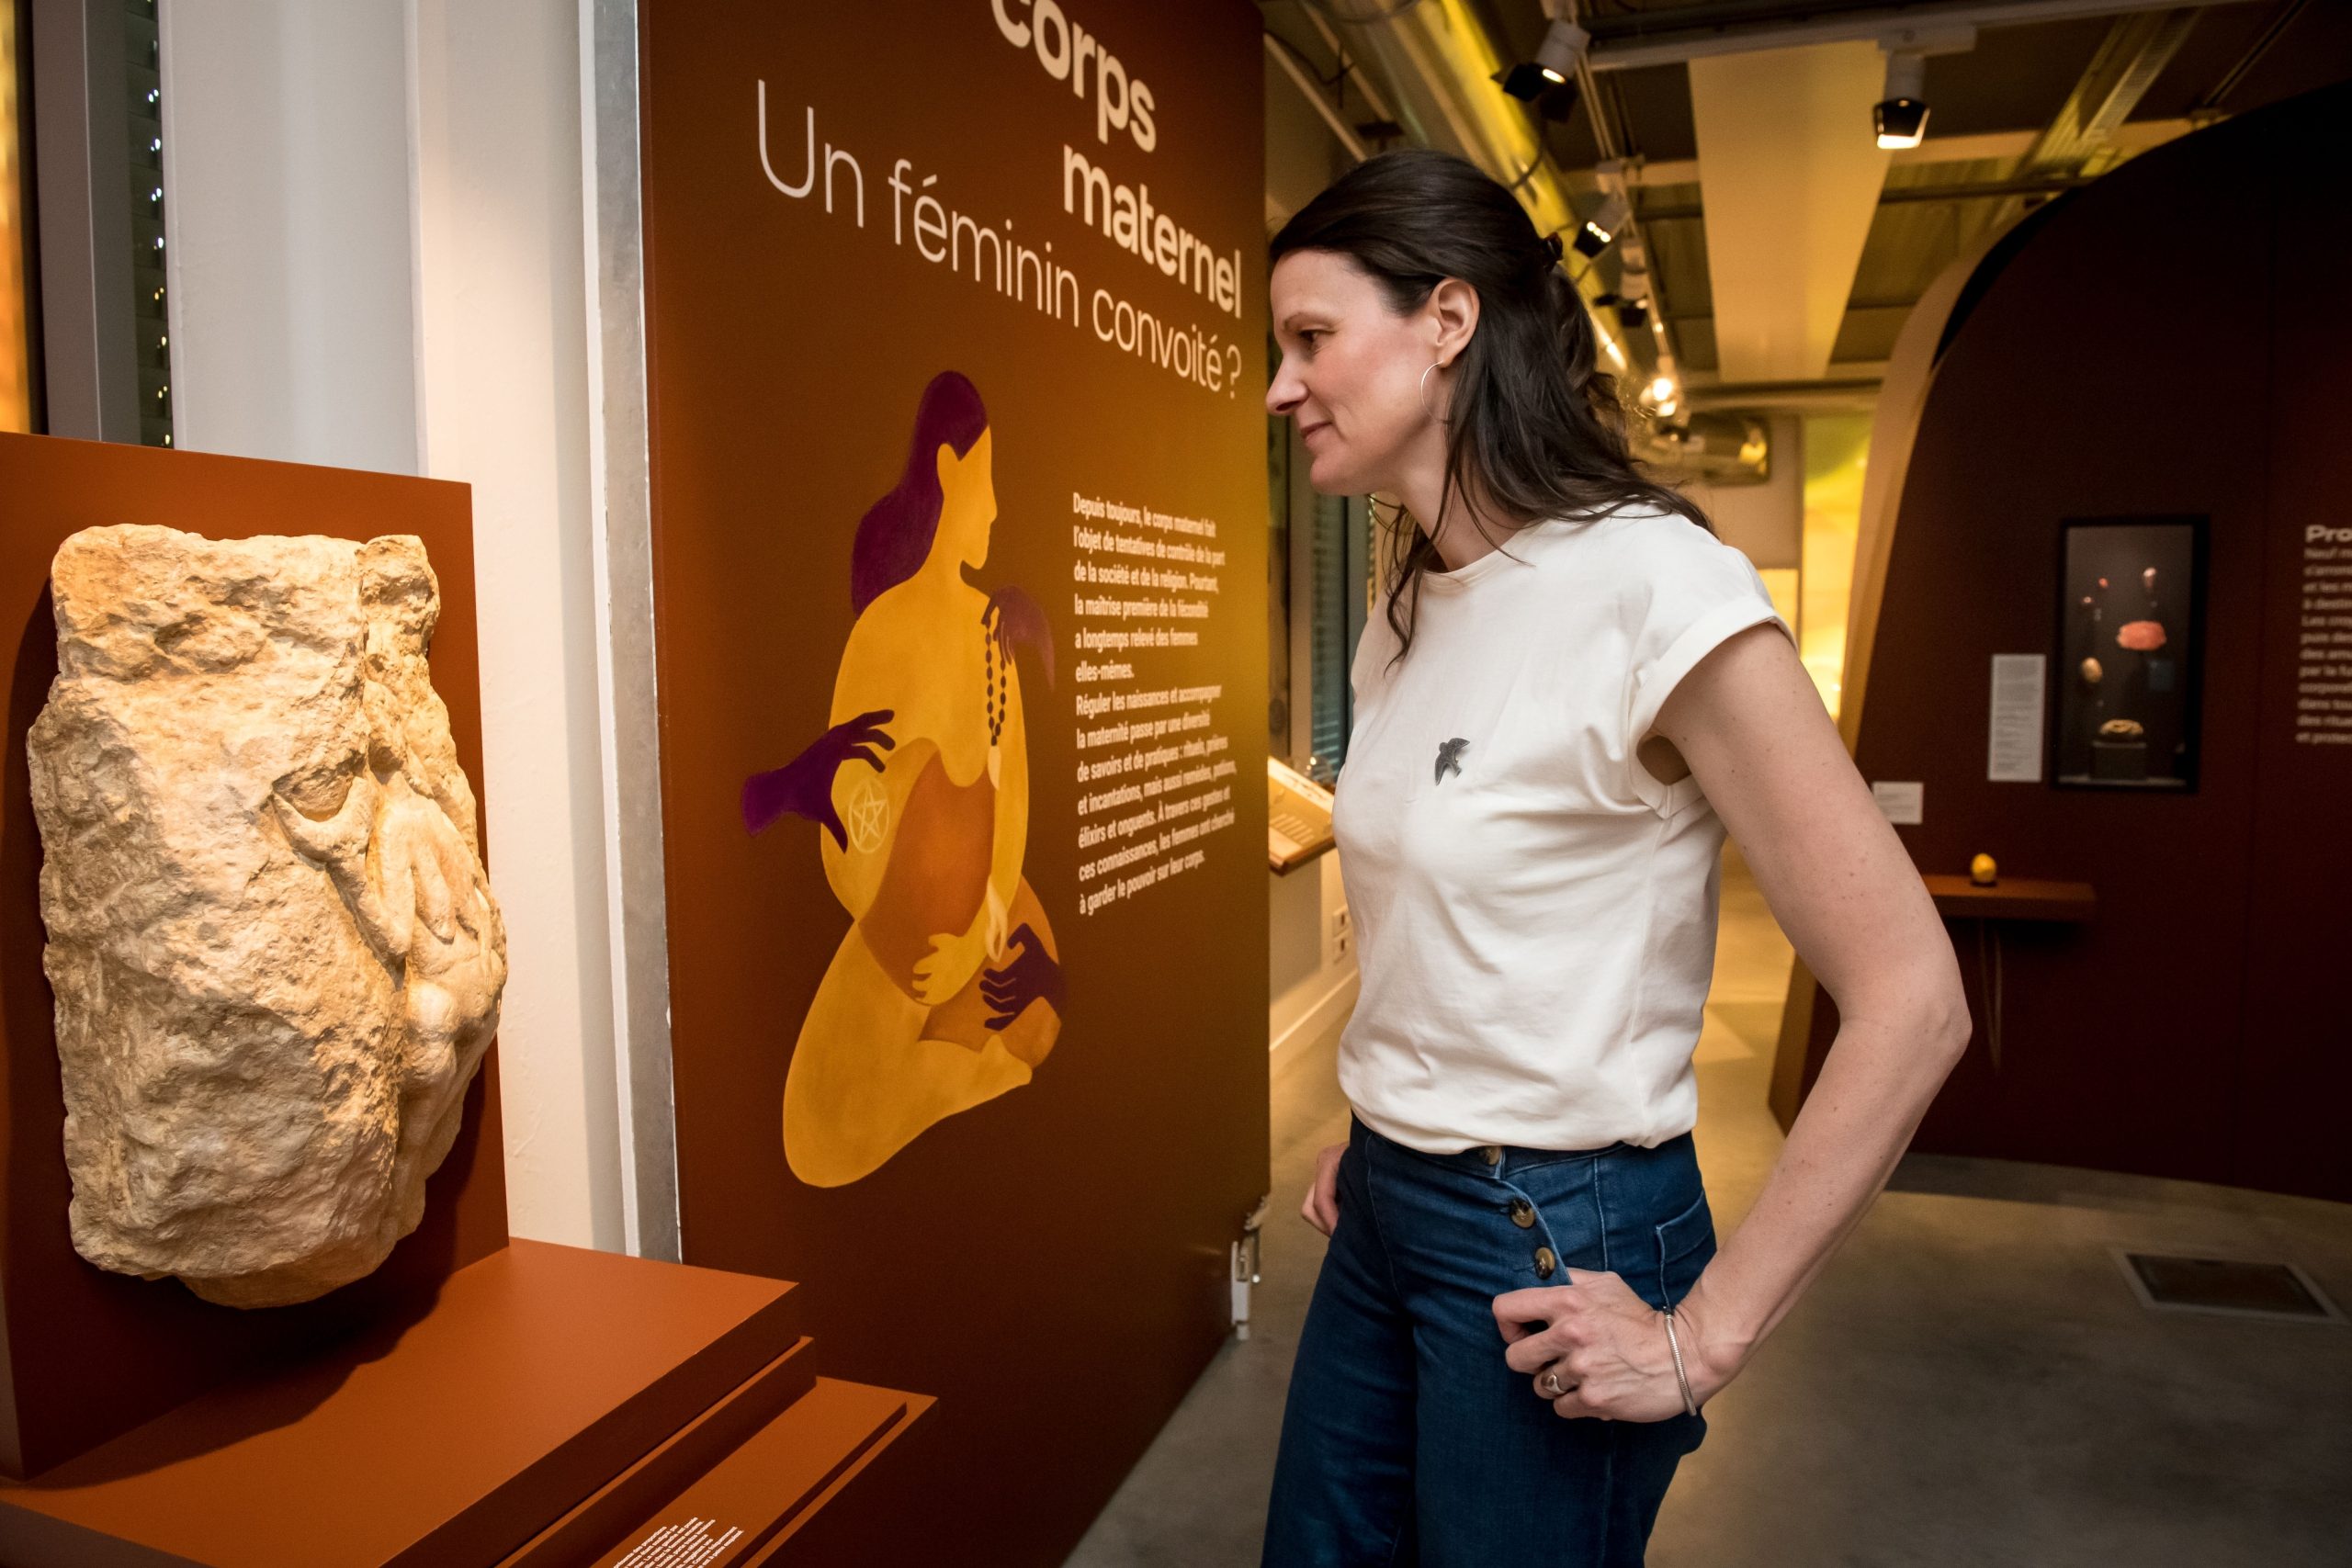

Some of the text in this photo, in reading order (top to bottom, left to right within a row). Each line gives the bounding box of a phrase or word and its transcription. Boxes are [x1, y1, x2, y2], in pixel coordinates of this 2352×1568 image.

[991, 0, 1158, 153] corps
[757, 79, 865, 228] Un
[888, 158, 1080, 328] féminin
[1063, 143, 1243, 319] maternel
[1073, 492, 1105, 520] Depuis
[1107, 501, 1143, 528] toujours,
[1144, 506, 1151, 526] le
[1153, 513, 1173, 533] corps
[1174, 516, 1204, 536] maternel
[1102, 530, 1114, 551] de
[1115, 535, 1155, 557] tentatives
[1156, 539, 1166, 558] de
[1167, 543, 1194, 561] contrôle
[1196, 546, 1204, 563] de
[1204, 547, 1211, 564] la
[1074, 559, 1086, 581] de
[1088, 560, 1096, 582] la
[1098, 564, 1129, 584] société
[1131, 569, 1139, 585] et
[1140, 567, 1150, 586] de
[1151, 568, 1159, 587] la
[1075, 593, 1083, 615] la
[1085, 595, 1121, 615] maîtrise
[1123, 597, 1158, 621] première
[1159, 598, 1169, 616] de
[1170, 599, 1176, 616] la
[1075, 627, 1198, 653] a longtemps relevé des femmes
[1076, 660, 1135, 682] elles-mêmes.
[1076, 694, 1111, 719] Réguler
[1113, 691, 1125, 711] les
[1126, 689, 1169, 709] naissances
[1170, 687, 1178, 704] et
[1077, 708, 1210, 750] la maternité passe par une diversité
[1078, 761, 1089, 783] de
[1091, 755, 1122, 779] savoirs
[1124, 753, 1132, 772] et
[1134, 750, 1144, 770] de
[1078, 795, 1088, 816] et
[1090, 784, 1143, 812] incantations,
[1144, 774, 1162, 796] mais
[1163, 770, 1182, 792] aussi
[1079, 824, 1106, 848] élixirs
[1107, 819, 1116, 839] et
[1118, 809, 1157, 837] onguents.
[1165, 801, 1189, 819] travers
[1190, 796, 1202, 811] ces
[1080, 863, 1095, 882] ces
[1097, 840, 1159, 874] connaissances,
[1159, 832, 1170, 851] les
[1171, 828, 1199, 846] femmes
[1199, 818, 1211, 835] ont
[1080, 894, 1086, 914] à
[1088, 884, 1116, 916] garder
[1117, 878, 1125, 897] le
[1126, 866, 1156, 898] pouvoir
[1157, 863, 1170, 881] sur
[1170, 857, 1183, 875] leur
